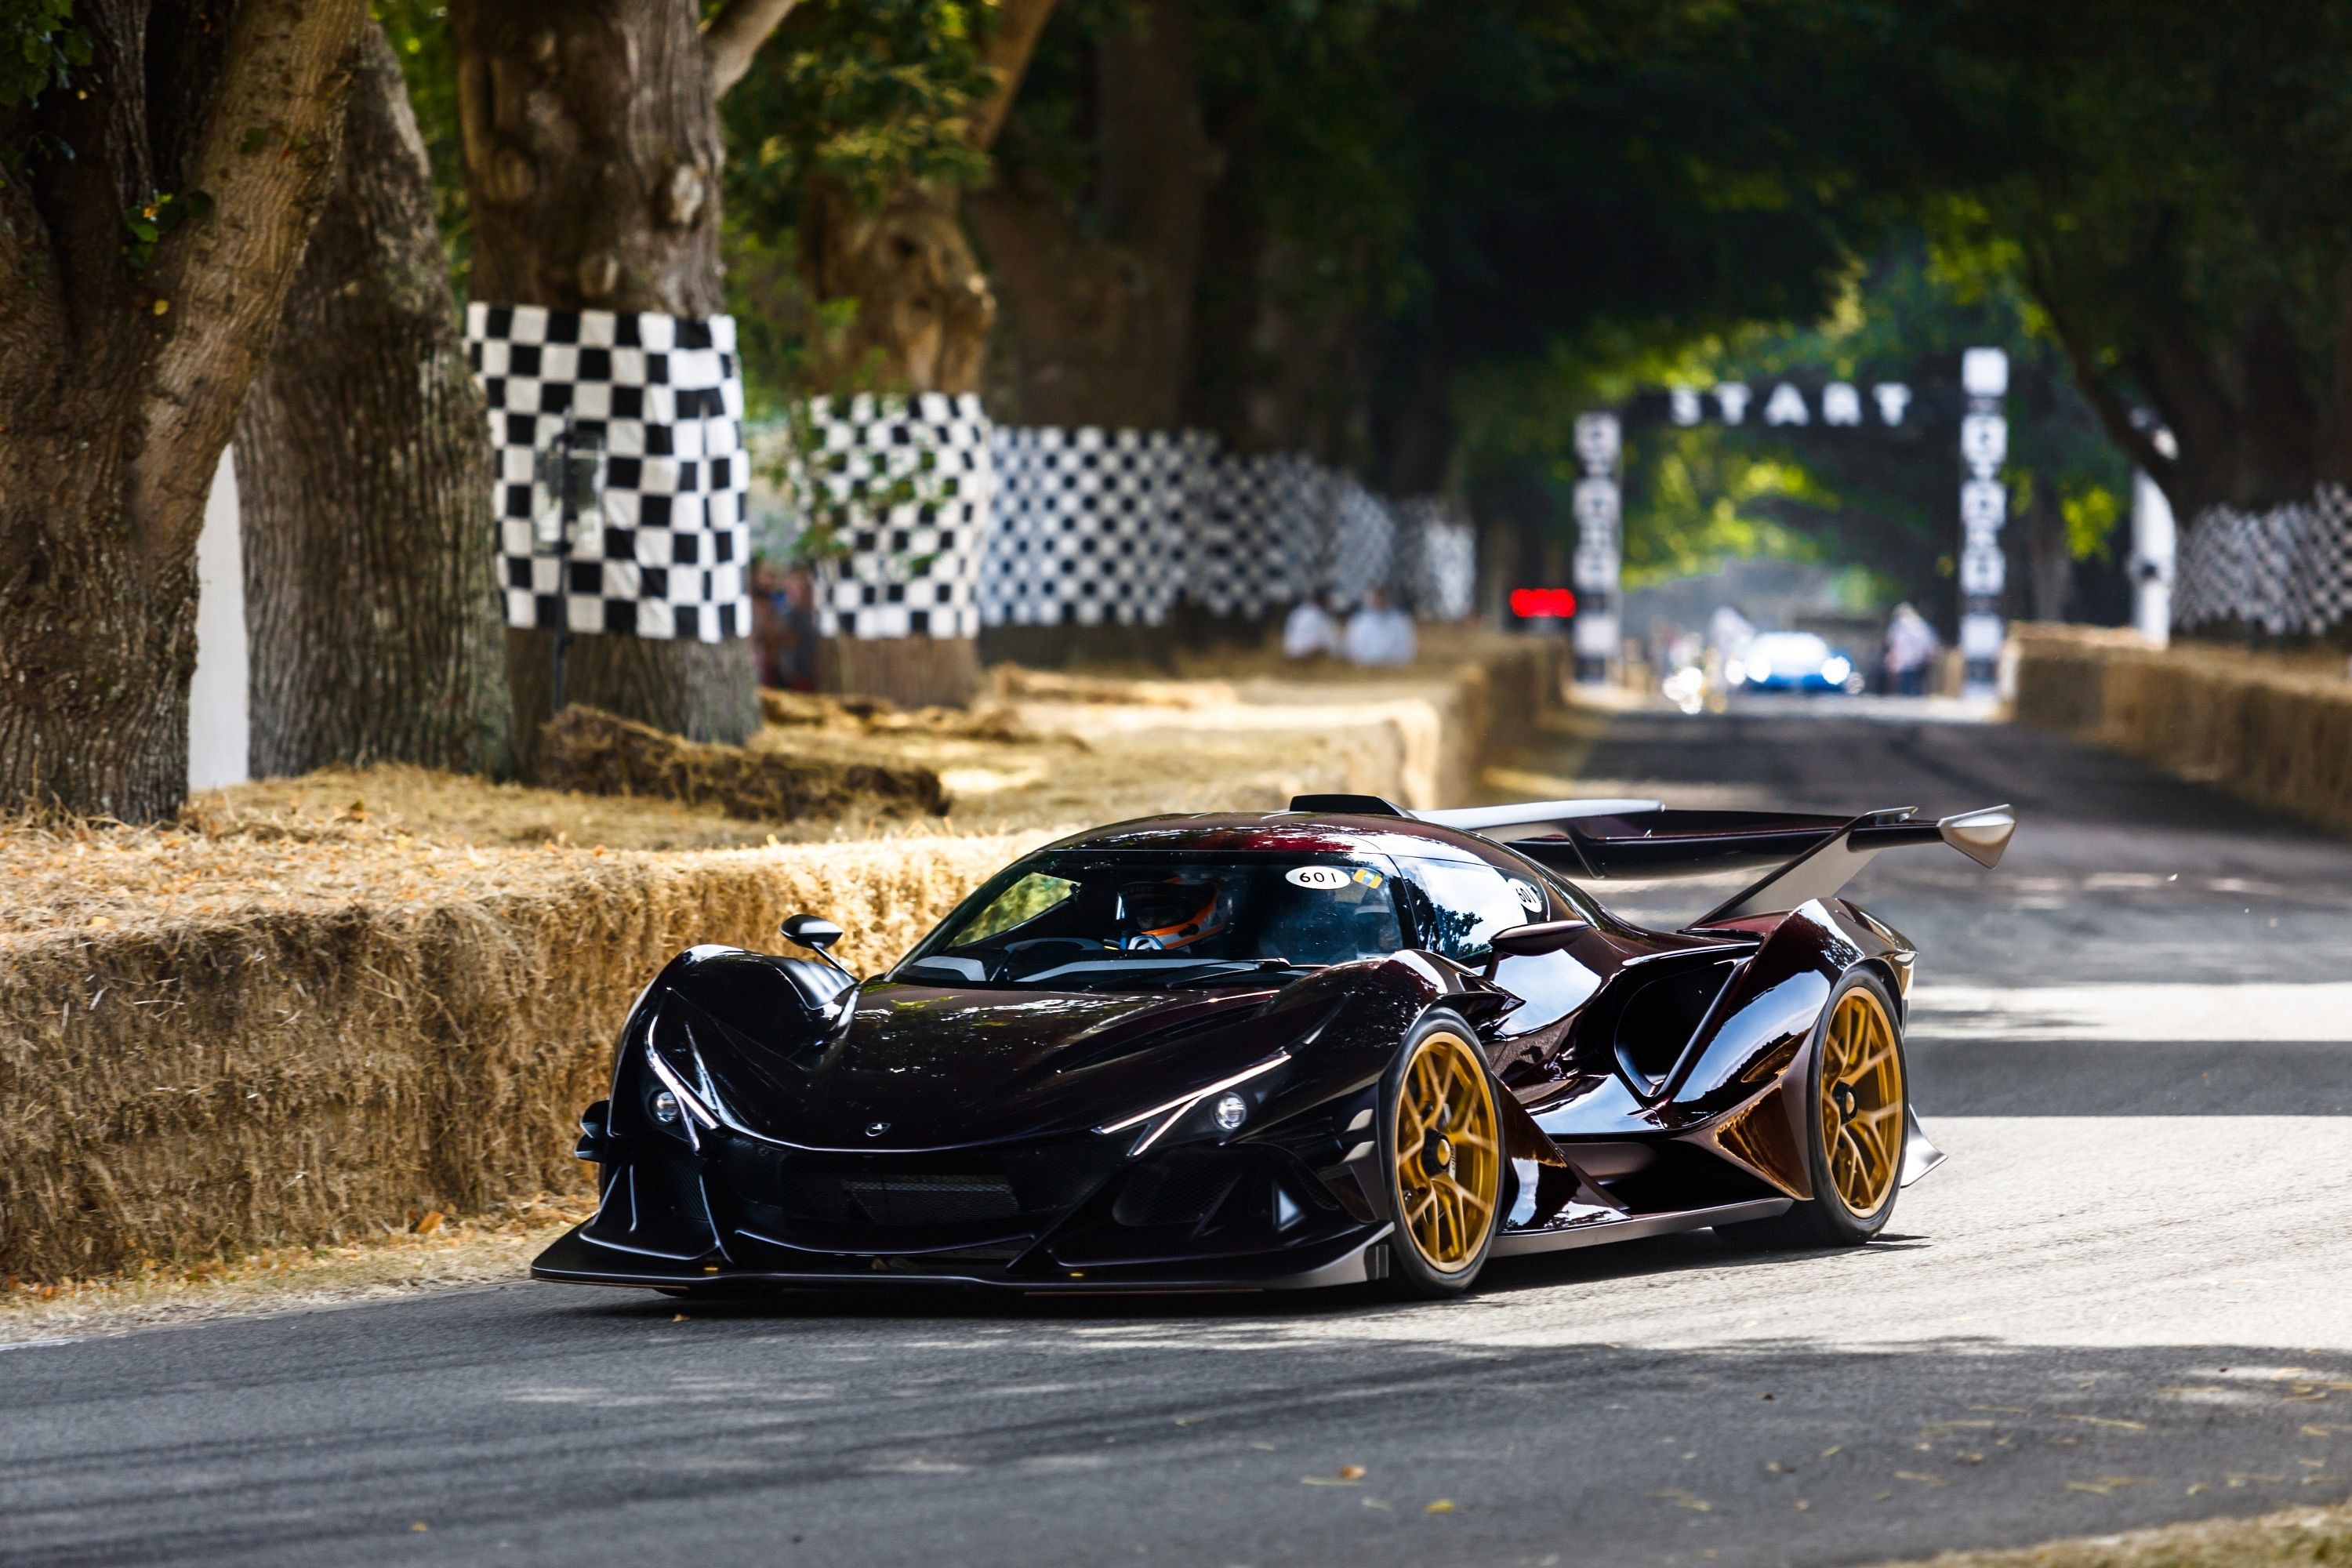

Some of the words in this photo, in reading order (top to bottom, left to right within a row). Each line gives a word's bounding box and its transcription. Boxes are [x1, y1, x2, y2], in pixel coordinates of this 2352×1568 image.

[1671, 381, 1911, 426] START
[1299, 872, 1337, 883] 601
[1515, 887, 1537, 903] 601
